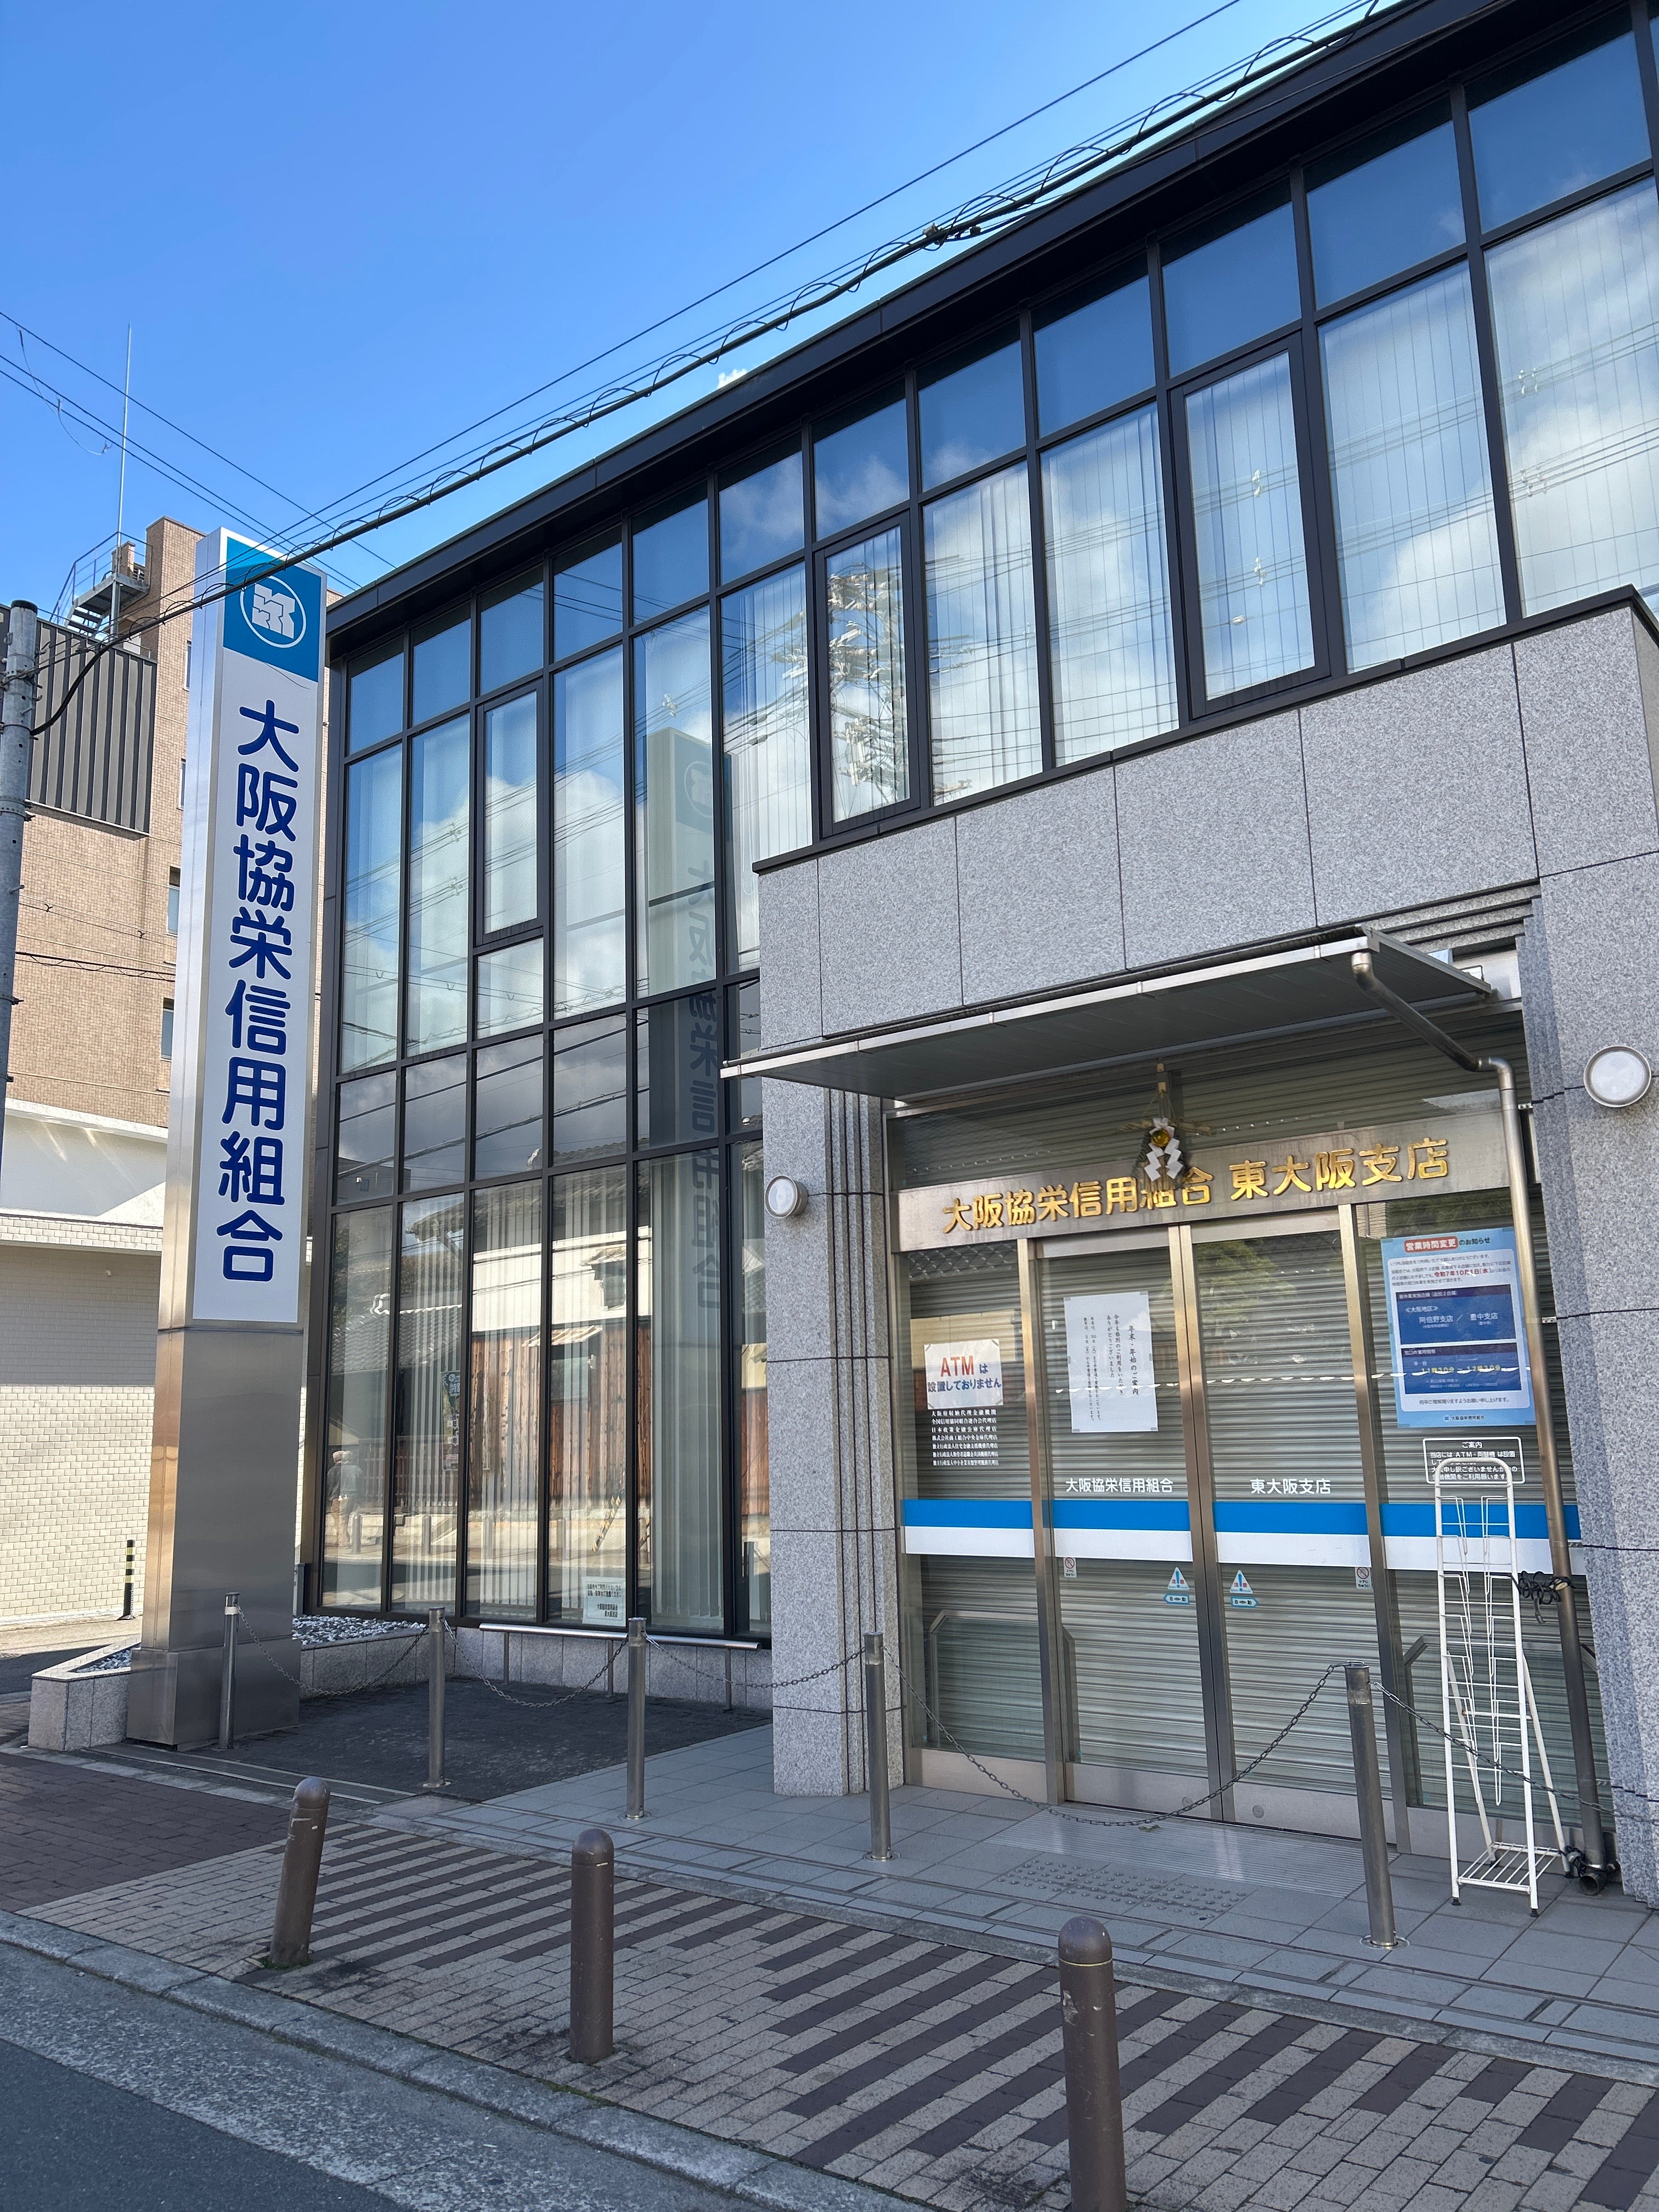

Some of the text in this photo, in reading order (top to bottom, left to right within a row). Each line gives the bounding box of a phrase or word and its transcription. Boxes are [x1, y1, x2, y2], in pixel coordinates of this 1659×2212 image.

[217, 699, 298, 1282] 大阪協栄信用組合
[1229, 1137, 1449, 1201] 東大阪支店
[940, 1355, 988, 1377] ATM は
[927, 1378, 1002, 1392] 設置しておりません
[1065, 1477, 1173, 1493] 大阪協栄信用組合
[1250, 1478, 1331, 1494] 東大阪支店
